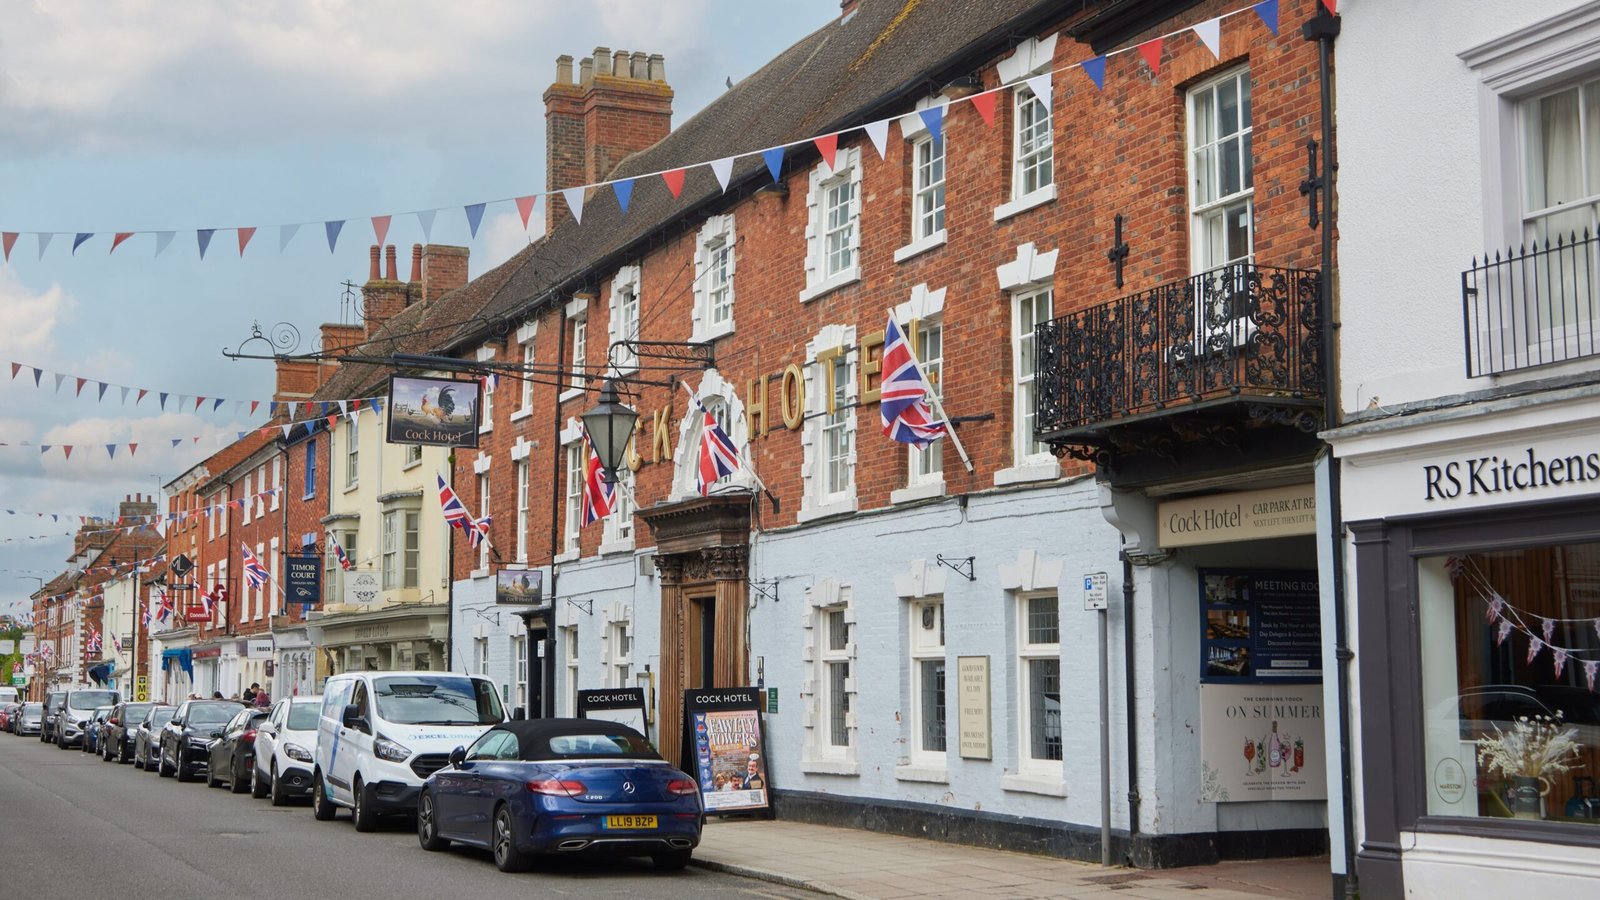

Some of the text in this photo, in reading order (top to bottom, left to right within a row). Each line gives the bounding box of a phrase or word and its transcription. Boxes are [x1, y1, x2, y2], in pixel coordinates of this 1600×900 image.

[405, 429, 461, 441] Cock Hotel
[1423, 447, 1600, 500] RS Kitchens
[1252, 497, 1316, 516] CAR PARK AT RE
[1169, 504, 1241, 534] Cock Hotel
[1253, 519, 1267, 528] NEXT
[1281, 516, 1296, 525] THEN
[1255, 581, 1299, 590] MEETING
[587, 693, 637, 703] COCK HOTEL
[695, 694, 752, 704] COCK HOTEL
[1226, 705, 1320, 718] ON SUMMER
[709, 717, 756, 734] FAWLTY
[711, 732, 758, 748] TOWERS
[610, 816, 654, 828] LL19 BZP
